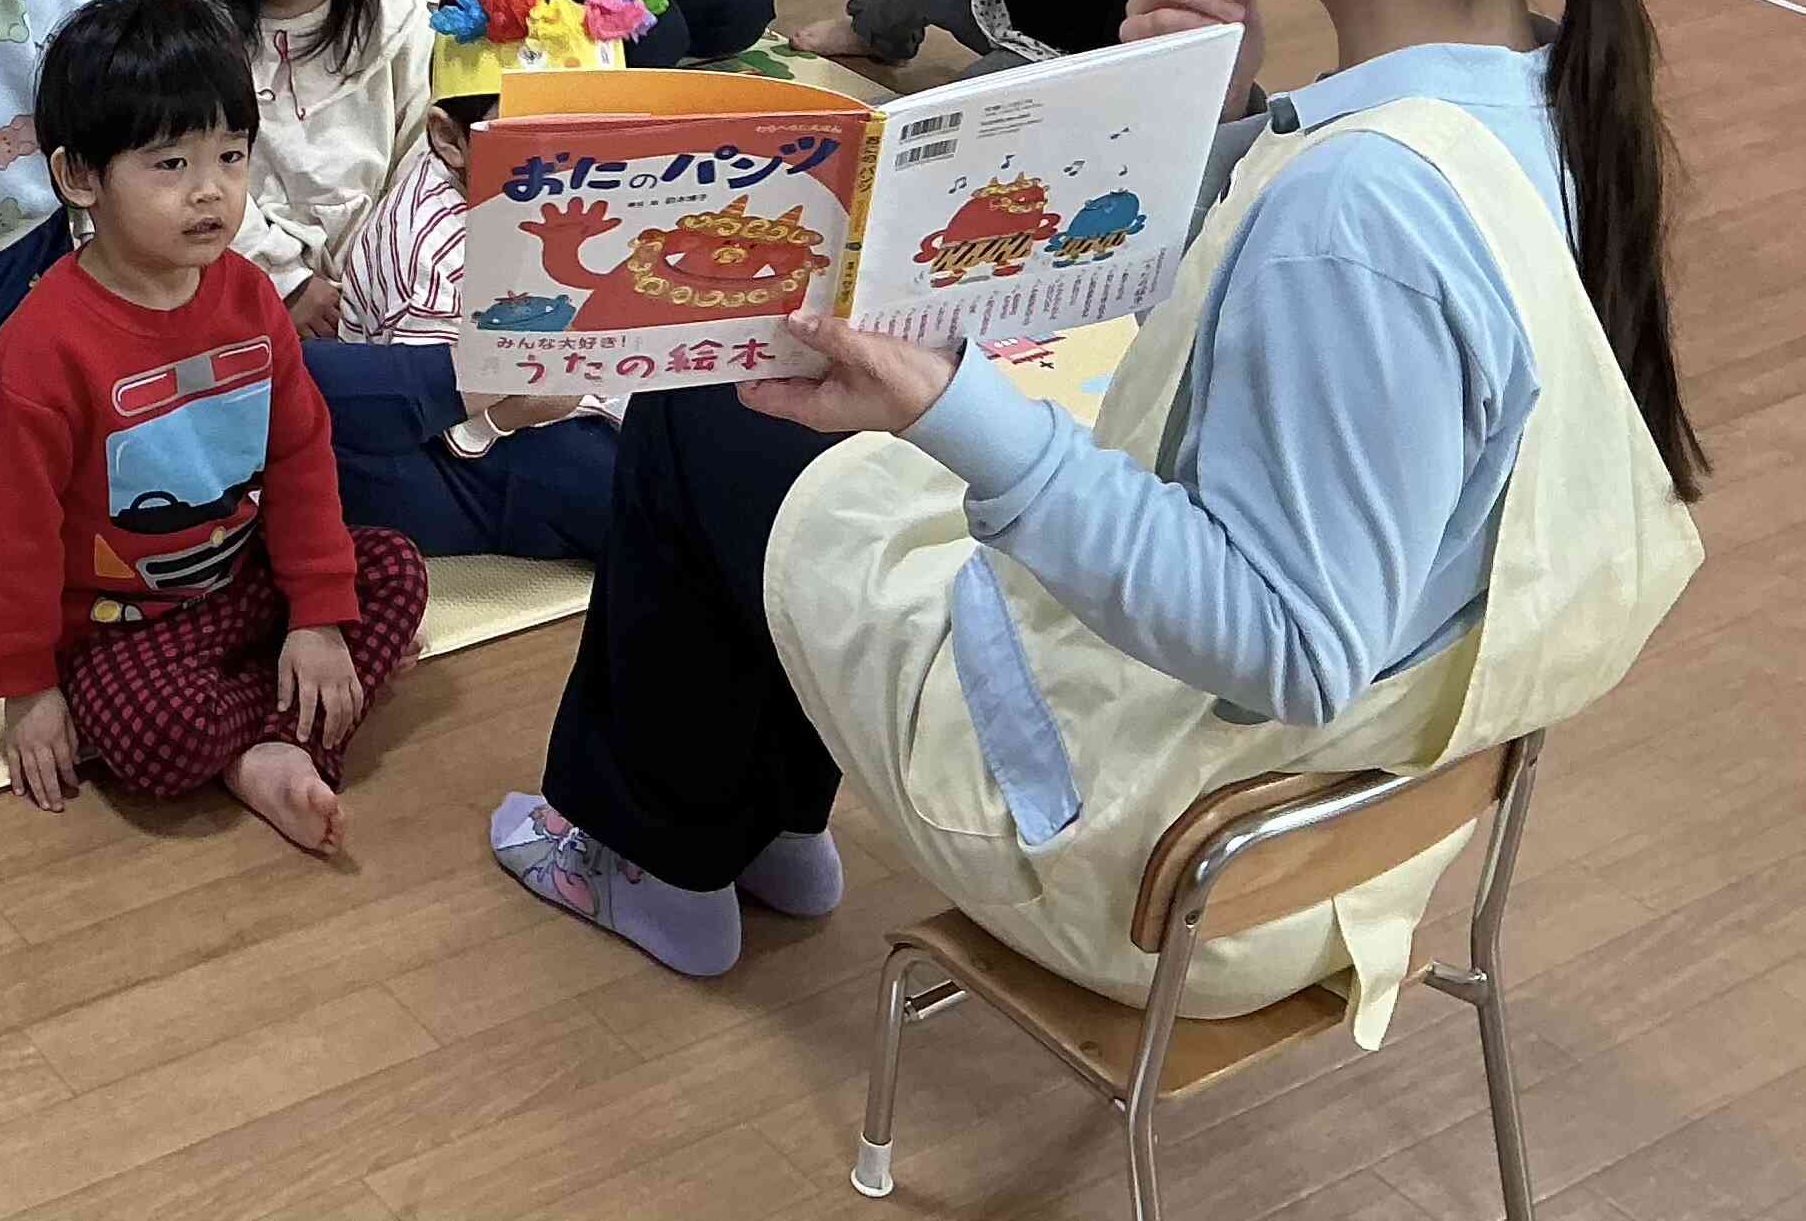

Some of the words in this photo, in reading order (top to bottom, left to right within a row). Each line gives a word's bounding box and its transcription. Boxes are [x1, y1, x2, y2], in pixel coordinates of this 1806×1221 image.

[502, 136, 841, 202] おにのパンツ
[497, 335, 626, 350] みんな大好き!
[516, 338, 776, 385] うたの絵本
